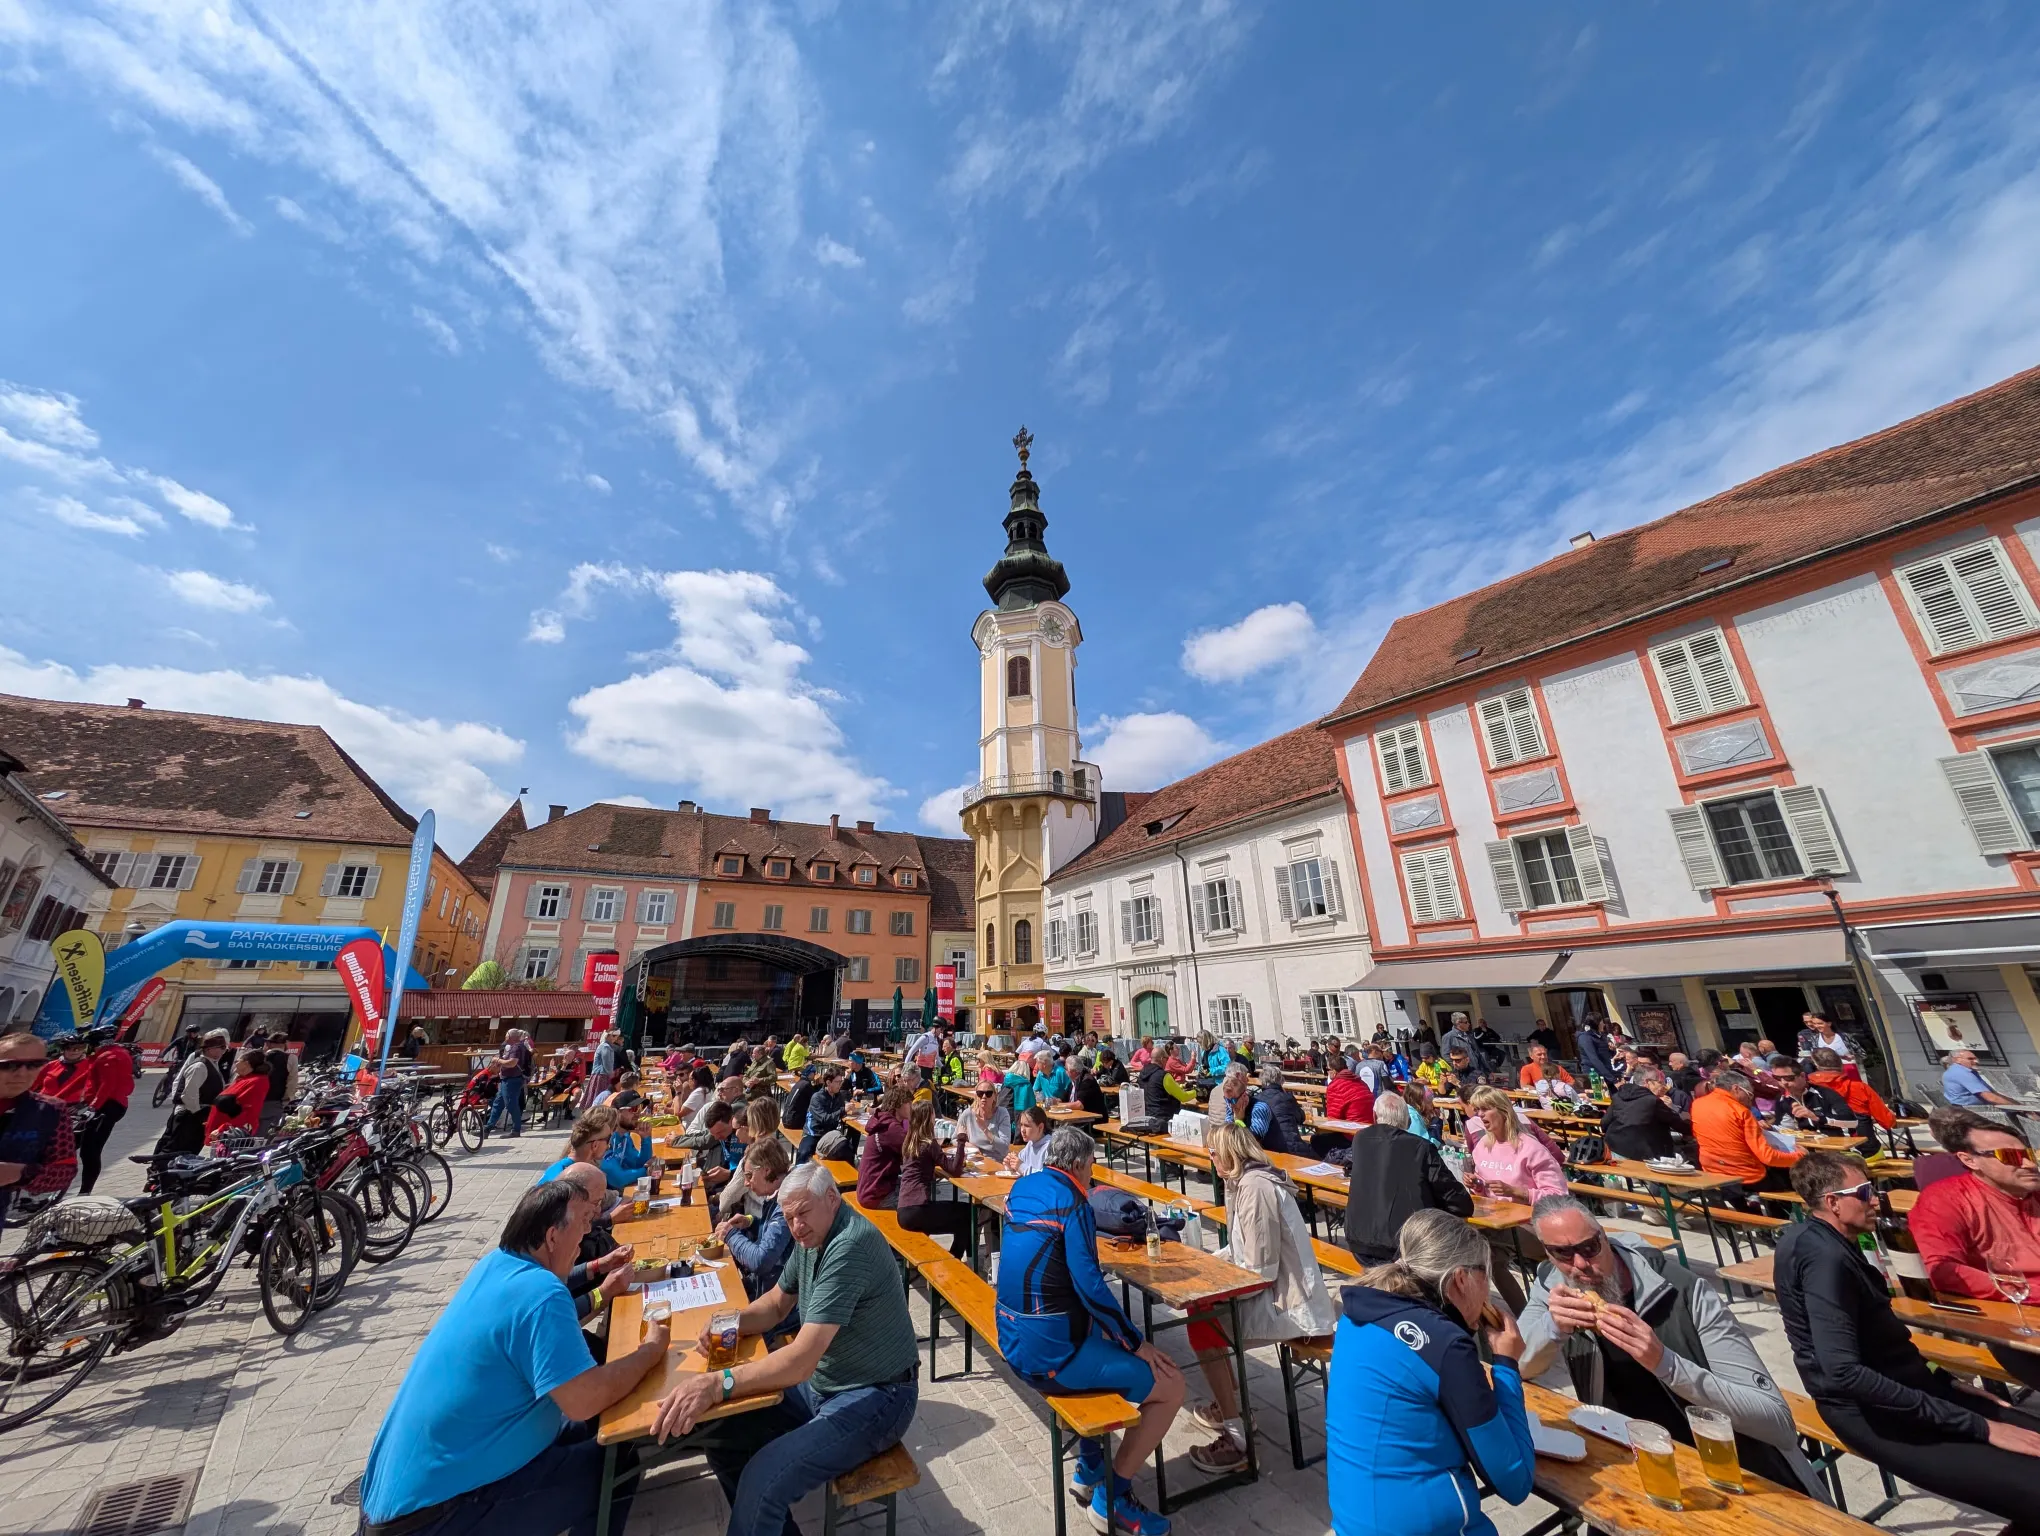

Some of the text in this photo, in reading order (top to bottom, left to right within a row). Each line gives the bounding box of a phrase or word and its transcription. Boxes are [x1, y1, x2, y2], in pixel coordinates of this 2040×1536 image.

[229, 930, 346, 945] PARKTHERME
[227, 941, 342, 952] BAD RADKERSBURG
